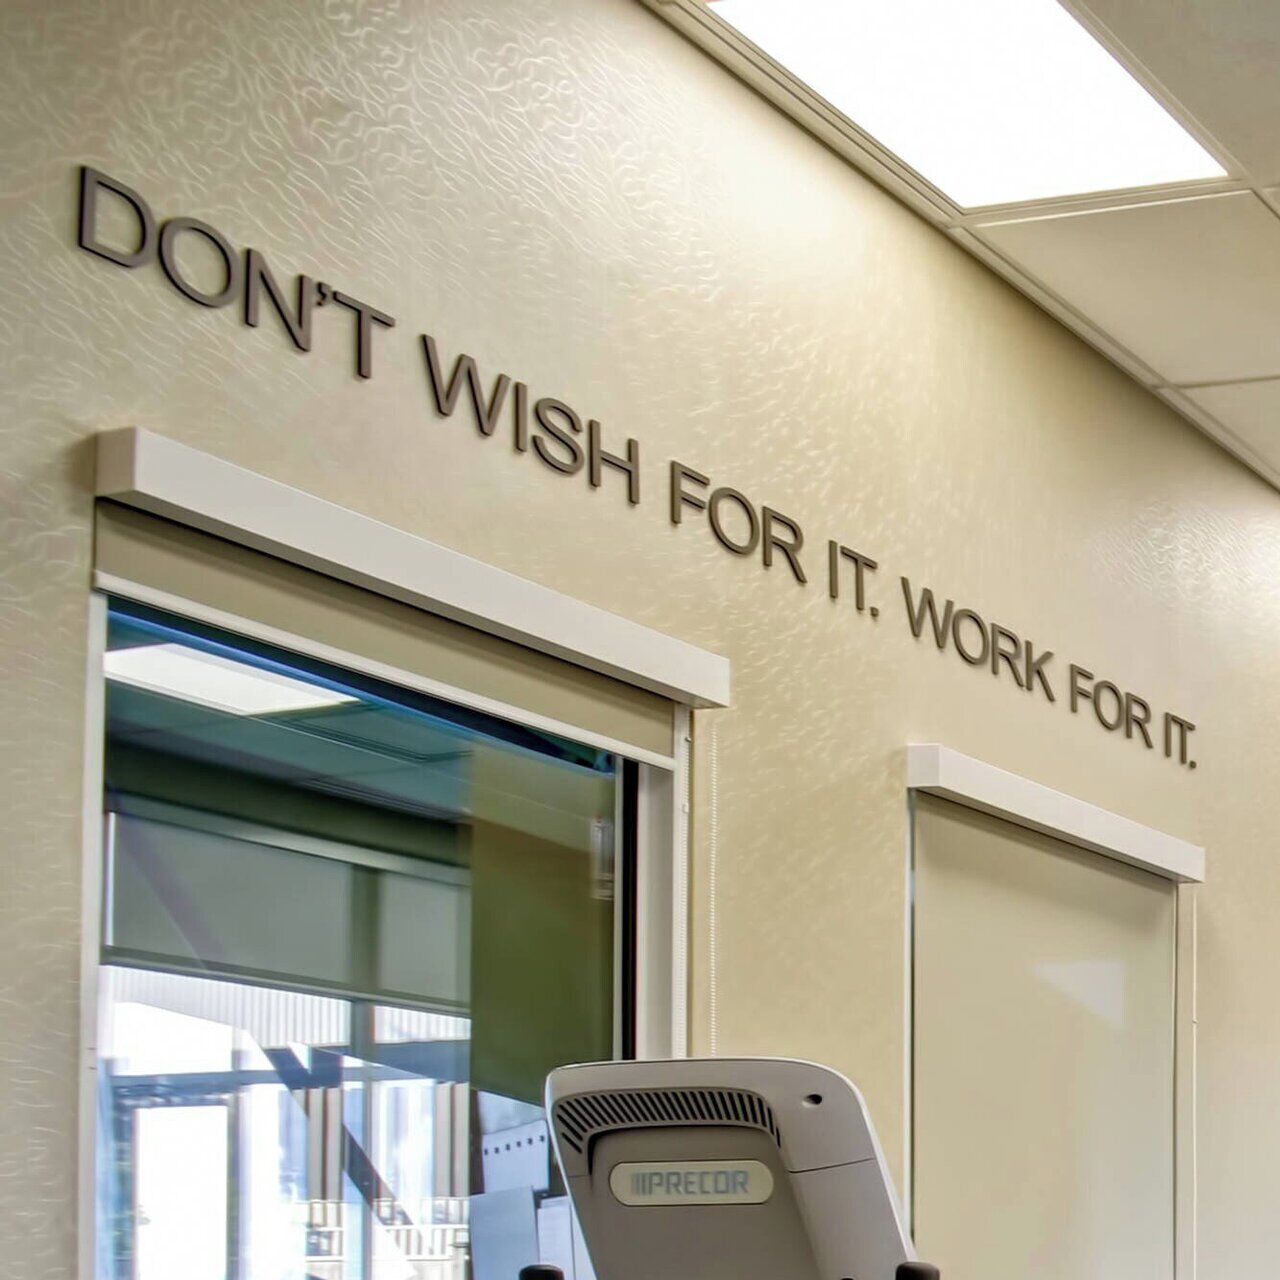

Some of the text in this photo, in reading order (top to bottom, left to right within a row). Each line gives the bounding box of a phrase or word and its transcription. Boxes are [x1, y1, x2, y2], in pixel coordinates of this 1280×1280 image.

[420, 333, 640, 505] WISH
[670, 460, 807, 584] FOR
[828, 540, 879, 618] IT.
[900, 576, 1056, 702] WORK
[1069, 663, 1154, 749] FOR
[1164, 711, 1197, 769] IT.
[648, 1170, 749, 1195] PRECOR
